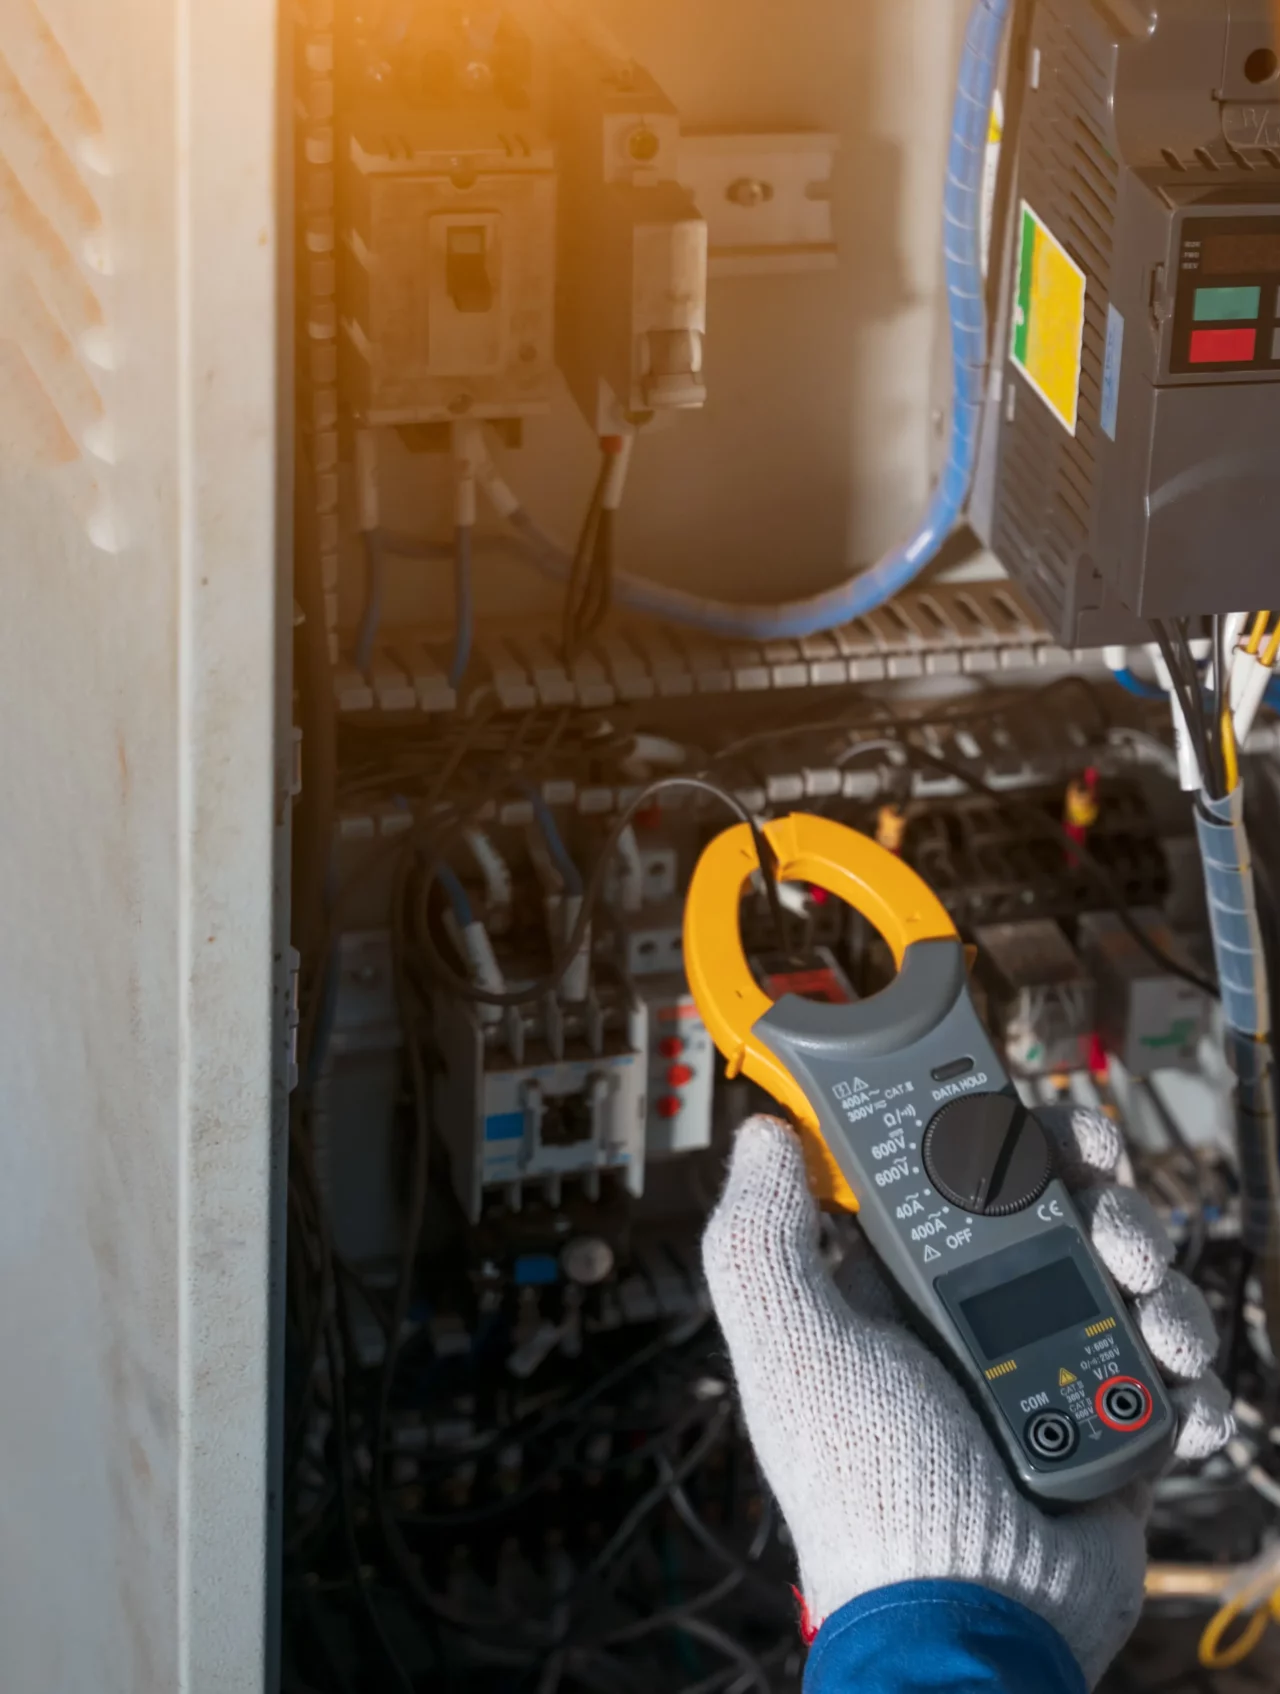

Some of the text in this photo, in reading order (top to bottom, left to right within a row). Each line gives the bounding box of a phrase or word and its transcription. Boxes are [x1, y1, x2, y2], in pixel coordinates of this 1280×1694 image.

[931, 1072, 988, 1101] DATA HOLD
[871, 1136, 906, 1159] 600V
[875, 1161, 909, 1187] 600V
[896, 1200, 924, 1219] 40A
[1037, 1200, 1064, 1221] CE
[911, 1219, 947, 1241] 400A
[946, 1228, 973, 1250] OFF
[1020, 1392, 1050, 1413] COM
